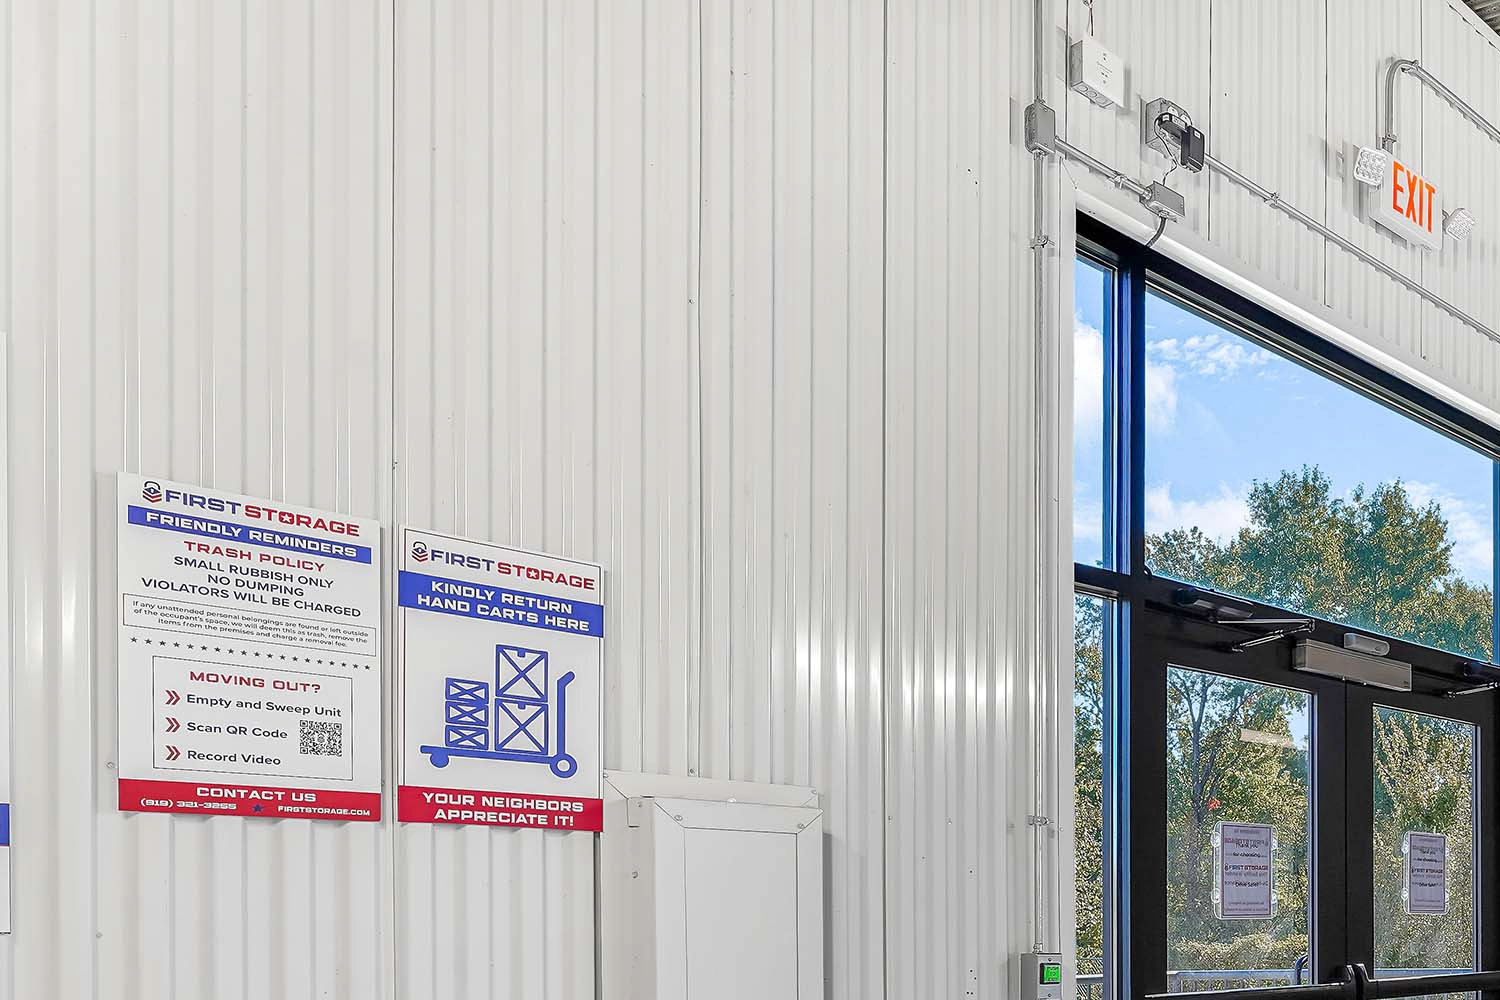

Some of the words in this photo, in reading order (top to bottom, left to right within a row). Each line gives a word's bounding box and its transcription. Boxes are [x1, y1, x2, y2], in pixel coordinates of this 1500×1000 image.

[1393, 161, 1436, 233] EXIT
[165, 489, 242, 514] FIRST
[244, 505, 360, 537] STORAGE
[146, 512, 242, 537] FRIENDLY
[249, 530, 357, 557] REMINDERS
[183, 541, 252, 560] TRASH
[259, 553, 325, 572] POLICY
[431, 549, 495, 571] FIRST
[497, 561, 595, 590] STORAGE
[174, 556, 224, 572] SMALL
[229, 564, 293, 583] RUBBISH
[298, 575, 334, 588] ONLY
[208, 574, 230, 585] NO
[235, 579, 304, 597] DUMPING
[141, 577, 229, 598] VIOLATORS
[233, 590, 267, 604] WILL
[272, 597, 290, 607] BE
[294, 600, 361, 617] CHARGED
[431, 580, 496, 602] KINDLY
[501, 592, 572, 614] RETURN
[157, 604, 204, 615] unattended
[206, 611, 240, 621] personal
[241, 615, 283, 626] belongings
[298, 623, 319, 631] found
[330, 626, 341, 634] left
[343, 629, 369, 637] outside
[160, 611, 203, 622] occupant's
[244, 621, 257, 629] will
[259, 624, 281, 632] deem
[328, 634, 355, 642] remove
[417, 594, 470, 613] HAND
[475, 604, 538, 623] CARTS
[545, 615, 590, 632] HERE
[183, 621, 203, 629] from
[220, 626, 255, 636] premises
[272, 633, 298, 642] charge
[305, 637, 334, 646] removal
[189, 671, 265, 688] MOVING
[272, 680, 321, 694] OUT?
[187, 694, 232, 709] Empty
[236, 699, 261, 710] and
[266, 701, 311, 716] Sweep
[314, 706, 342, 717] Unit
[187, 722, 222, 734] Scan
[226, 725, 248, 736] QR
[252, 727, 288, 739] Code
[187, 750, 237, 762] Record
[241, 753, 281, 765] Video
[140, 797, 173, 808] (919)
[196, 786, 285, 801] CONTACT
[292, 791, 317, 803] US
[422, 792, 475, 806] YOUR
[481, 796, 584, 813] NEIGHBORS
[277, 805, 371, 816] FIRSTSTORAGE.COM
[434, 808, 548, 825] APPRECIATE
[554, 815, 574, 827] IT!
